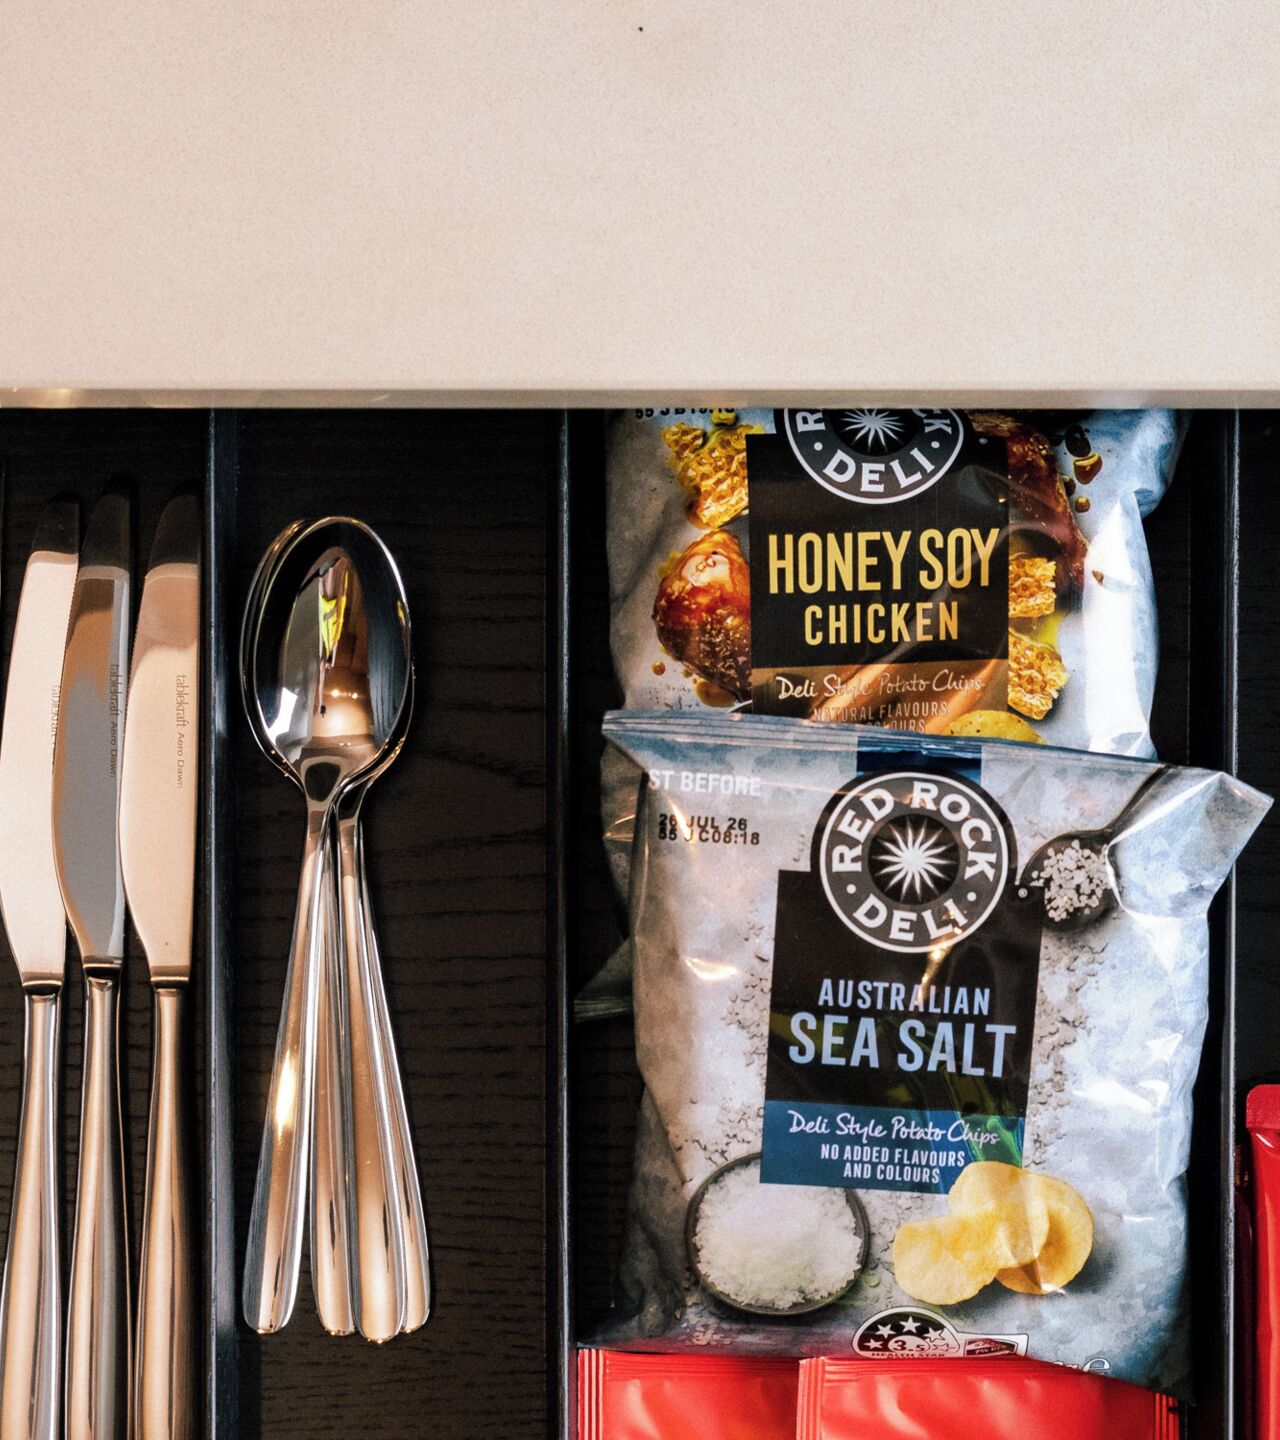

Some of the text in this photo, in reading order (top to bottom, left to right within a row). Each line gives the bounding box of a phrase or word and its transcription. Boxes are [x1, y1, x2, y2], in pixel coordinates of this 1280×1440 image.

[822, 448, 935, 492] DELI
[768, 527, 1000, 595] HONEY SOY
[804, 602, 959, 646] CHICKEN
[110, 664, 123, 716] tablekraft
[776, 676, 818, 700] Deli
[878, 672, 931, 696] Potato
[932, 669, 985, 699] Chips
[879, 701, 949, 719] FLAVOURS
[110, 722, 118, 745] Aero
[176, 674, 190, 788] tablekraft Aero Dawn
[680, 771, 761, 796] BEFORE
[686, 816, 719, 830] JUL
[727, 818, 748, 831] 26
[832, 780, 997, 882] RED ROCK
[852, 893, 968, 941] DELI
[818, 979, 991, 1016] AUSTRALIAN
[789, 1012, 1017, 1078] SEA SALT
[788, 1110, 1000, 1149] Deli Style Potato Chips
[821, 1144, 965, 1167] NO ADDED FLAVOURS
[843, 1163, 940, 1184] AND COLOURS
